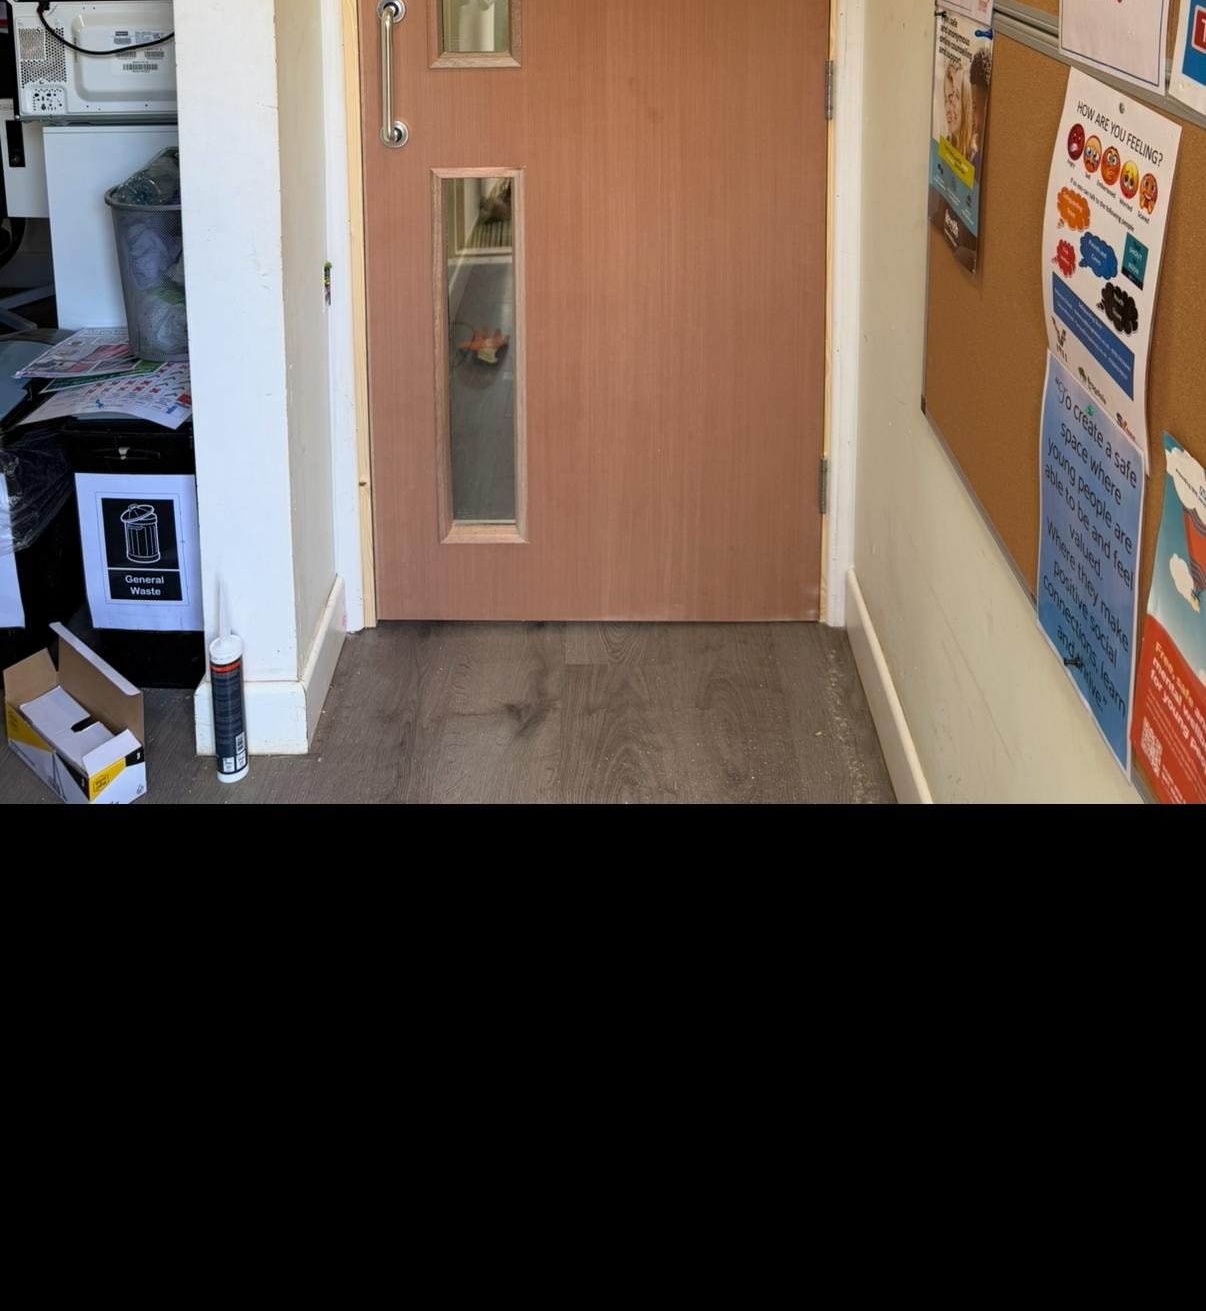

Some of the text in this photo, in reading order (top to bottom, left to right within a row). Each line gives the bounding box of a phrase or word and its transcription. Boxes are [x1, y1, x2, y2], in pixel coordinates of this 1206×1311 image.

[1076, 100, 1164, 167] HOW ARE YOU FEELING?
[1060, 422, 1121, 505] space where
[1073, 403, 1104, 448] create
[1105, 441, 1112, 458] a
[1114, 451, 1138, 489] safe
[1044, 463, 1134, 590] able to be and feel
[1048, 438, 1133, 555] young people are
[125, 574, 165, 584] General
[1047, 516, 1129, 653] Where they make
[1069, 523, 1103, 581] valued.
[129, 586, 161, 596] Waste
[1053, 560, 1118, 669] positive social
[1043, 575, 1126, 716] connections, learn
[1057, 624, 1075, 659] and
[1150, 669, 1163, 693] for
[1162, 691, 1190, 739] young
[1153, 656, 1183, 708] mental
